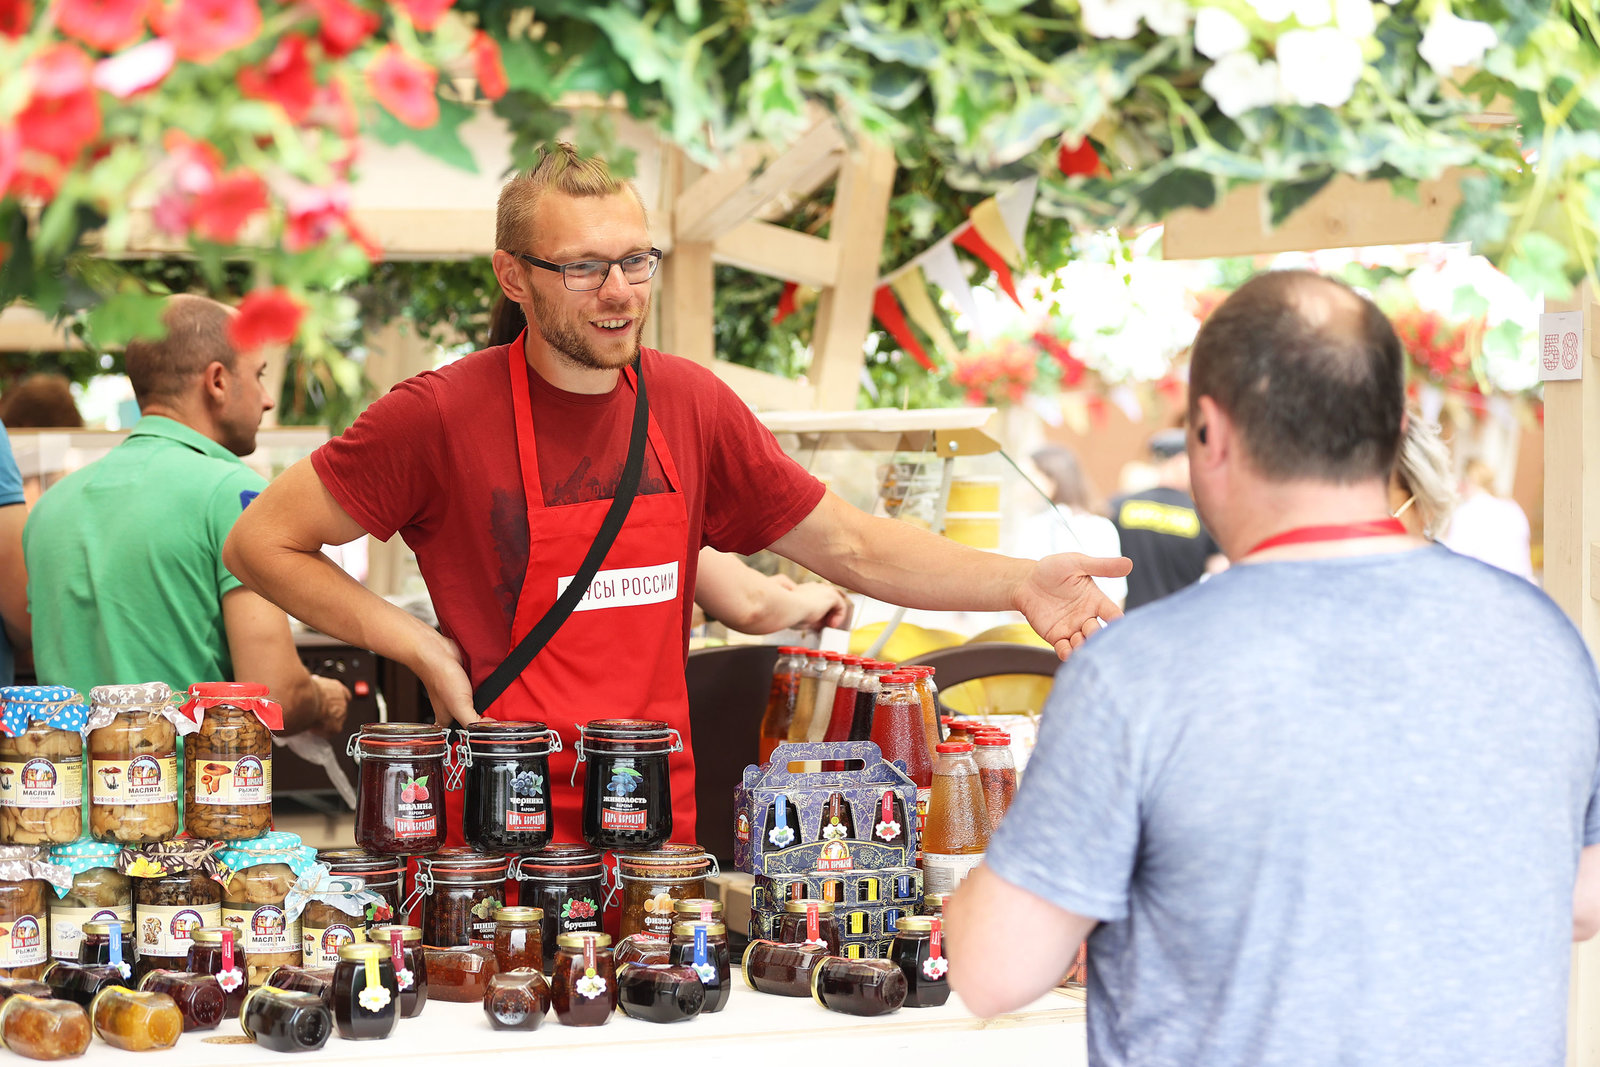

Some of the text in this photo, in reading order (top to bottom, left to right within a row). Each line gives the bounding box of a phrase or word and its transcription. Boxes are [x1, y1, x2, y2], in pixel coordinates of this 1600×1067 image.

[1543, 332, 1578, 371] 58
[621, 572, 674, 597] РОССИИ
[128, 786, 161, 794] МАСЛЯТА
[509, 797, 544, 806] черника
[398, 803, 433, 811] малина
[564, 920, 597, 930] брусника
[644, 916, 673, 926] физал
[15, 946, 38, 955] РЫЖИК
